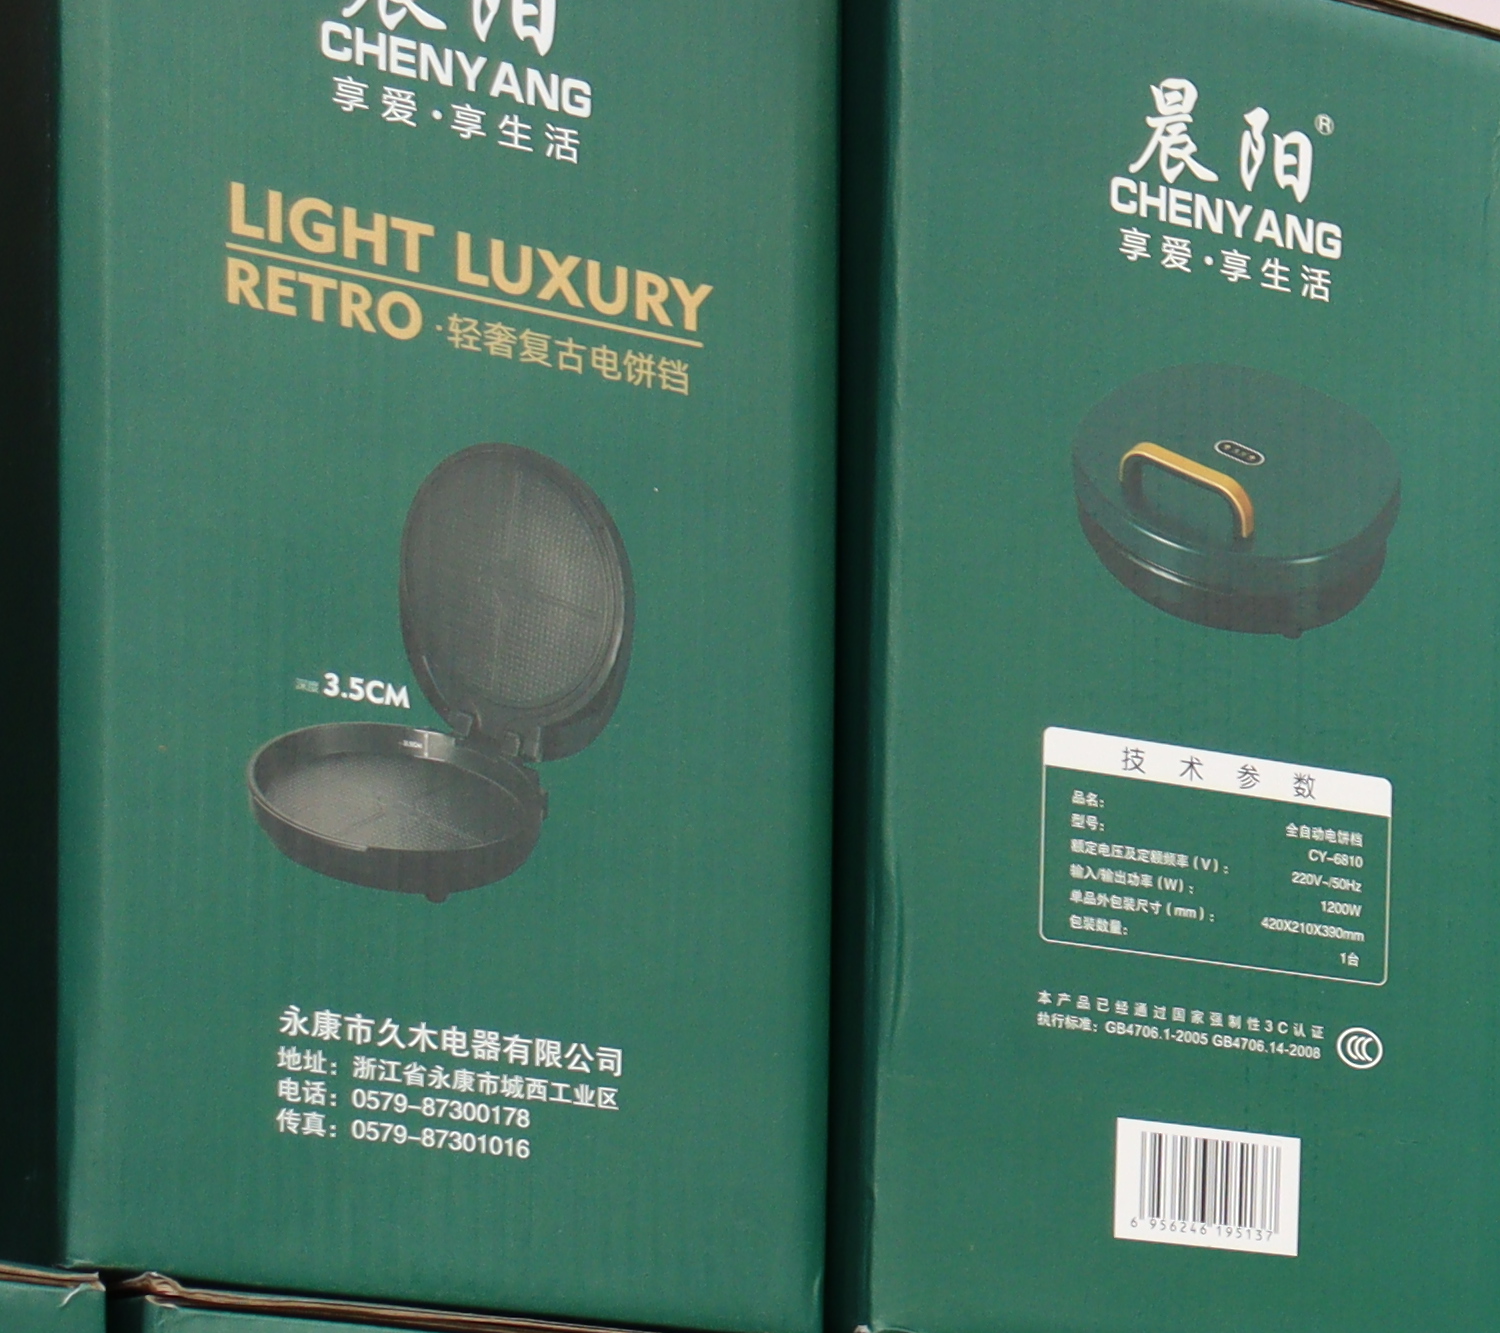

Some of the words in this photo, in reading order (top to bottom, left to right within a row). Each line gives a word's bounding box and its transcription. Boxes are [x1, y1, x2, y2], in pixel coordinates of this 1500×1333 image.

[321, 20, 592, 118] CHENYANG
[331, 75, 581, 163] 享爱·享生活
[1129, 78, 1313, 203] 晨阳
[229, 181, 435, 272] LIGHT
[457, 231, 714, 332] LUXURY
[1110, 176, 1341, 259] CHENYANG
[226, 256, 423, 341] RETRO
[1119, 227, 1332, 302] 享爱·享生活
[323, 672, 410, 709] 3.5CM
[1121, 746, 1316, 800] 技术参数
[1308, 849, 1363, 869] CY-6810
[1321, 900, 1362, 917] 1200W
[278, 1004, 624, 1076] 永康市久木电器有限公司
